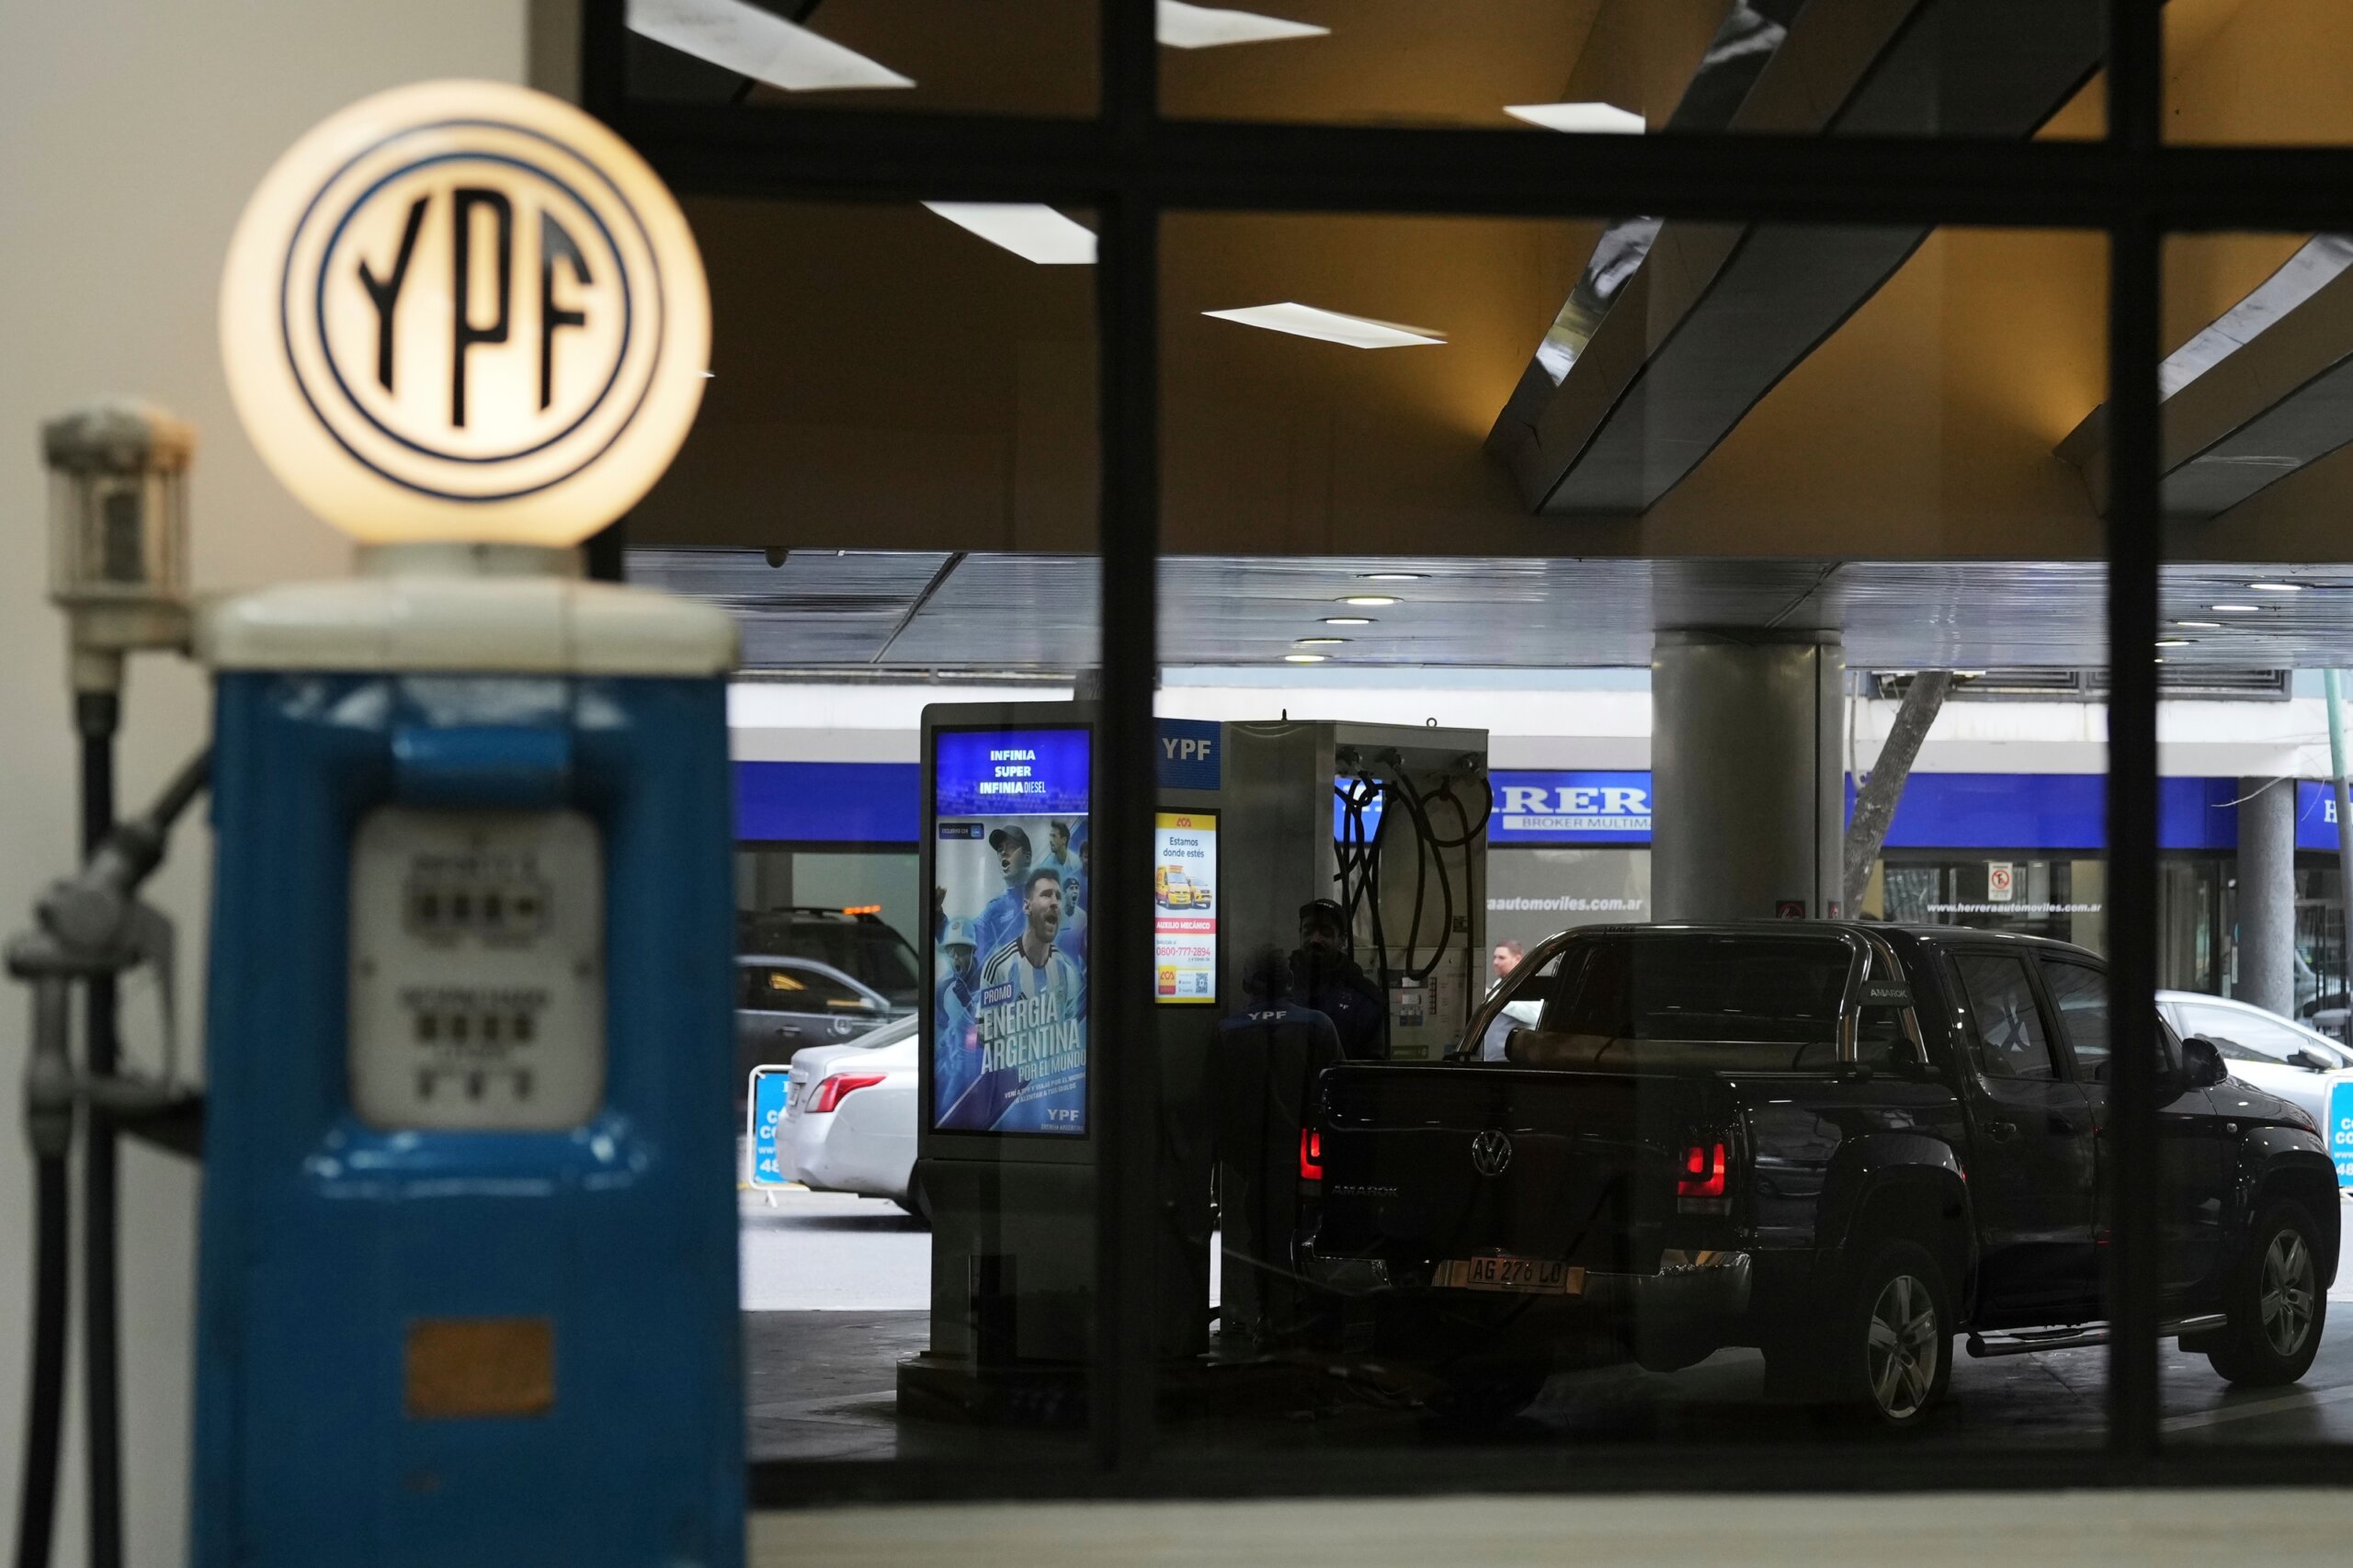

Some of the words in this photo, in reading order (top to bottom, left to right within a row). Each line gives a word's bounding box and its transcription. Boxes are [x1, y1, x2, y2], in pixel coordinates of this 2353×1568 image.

[357, 187, 594, 429] YPF
[990, 749, 1036, 761] INFINIA
[1161, 737, 1211, 761] YPF
[995, 766, 1032, 778] SUPER
[1491, 787, 1652, 814] RER
[1522, 818, 1583, 828] BROKER
[1169, 836, 1199, 846] Estamos
[1163, 847, 1186, 858] donde
[1927, 903, 2102, 914] www.herreraautomoviles.com.ar
[1156, 921, 1179, 929] AUXILIO
[1155, 947, 1211, 957] 0800-777-2894
[983, 984, 1012, 1006] PROMO
[1870, 988, 1908, 998] AMAROK
[983, 985, 1059, 1041] ENERGÍA
[1247, 1011, 1288, 1021] YPF
[981, 1017, 1081, 1075] ARGENTINA
[1017, 1063, 1038, 1083] POR
[1039, 1060, 1050, 1078] EL
[1051, 1050, 1086, 1074] MUNDO
[1047, 1108, 1080, 1121] YPF
[1473, 1258, 1495, 1281] AG
